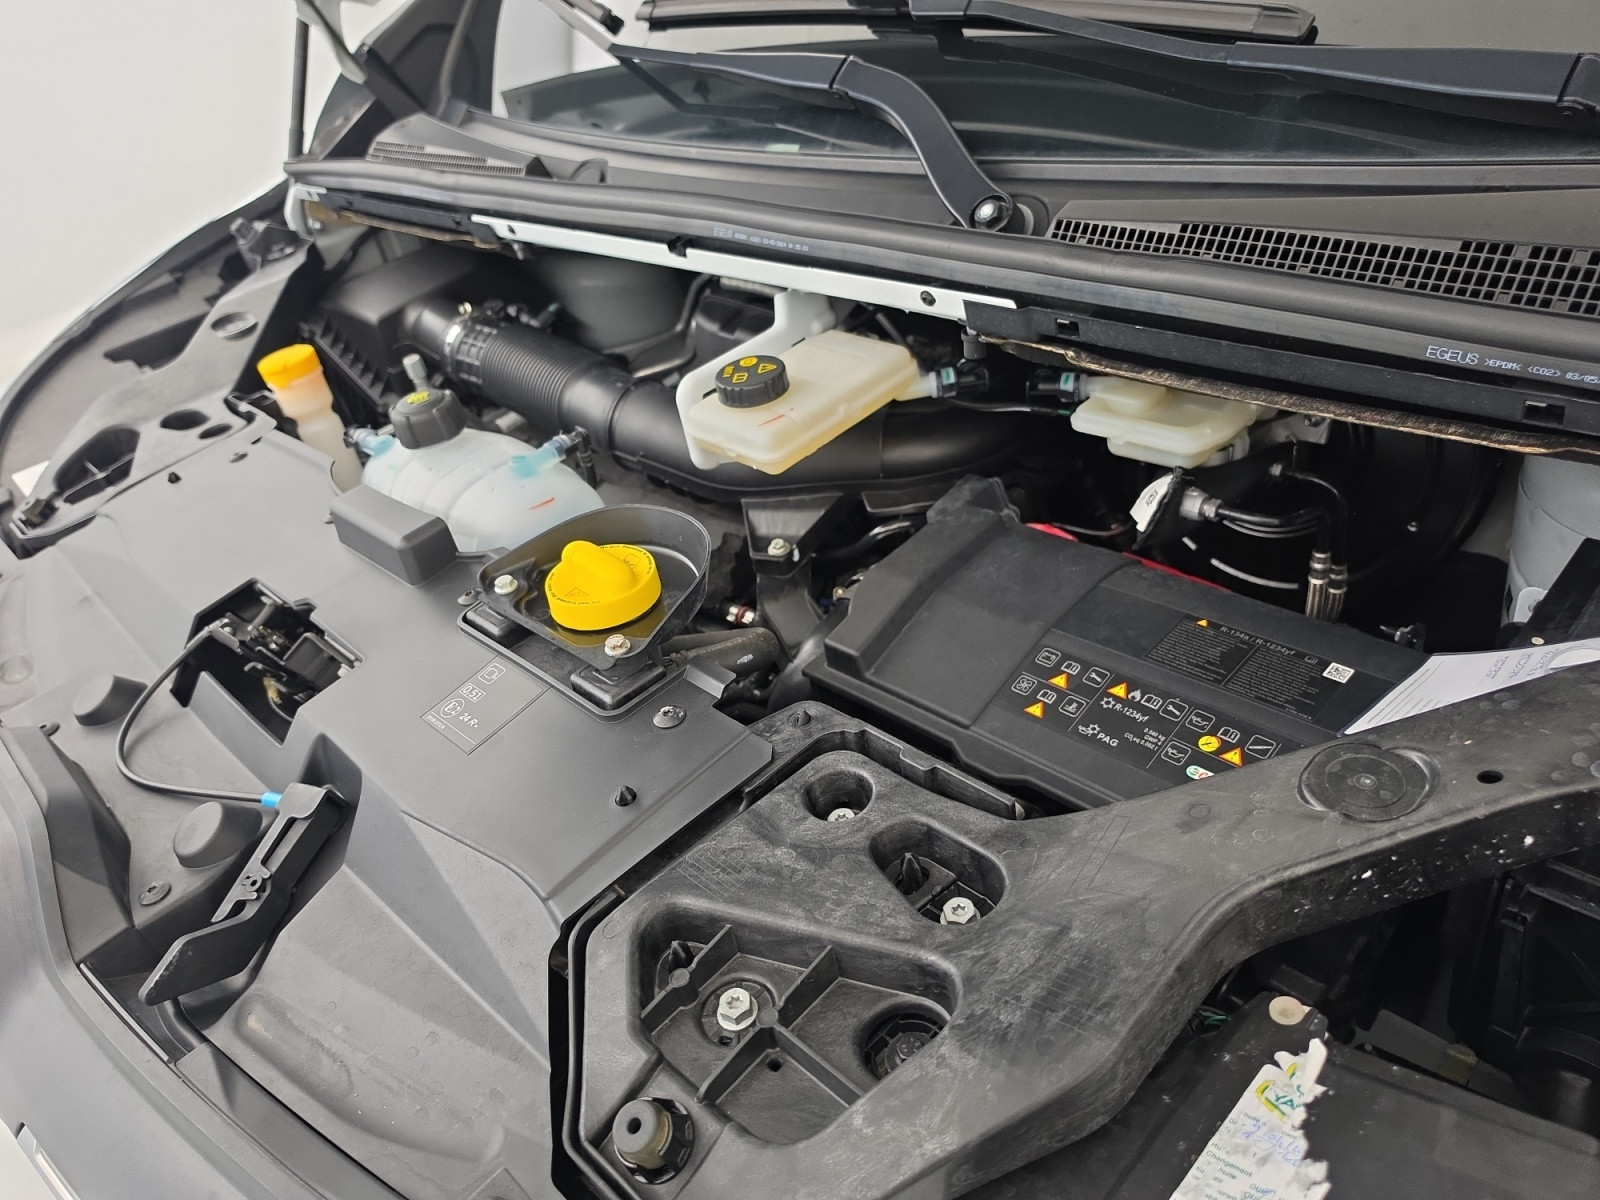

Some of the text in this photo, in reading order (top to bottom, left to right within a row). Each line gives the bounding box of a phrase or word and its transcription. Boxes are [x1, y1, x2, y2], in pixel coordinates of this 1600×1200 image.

[1426, 345, 1480, 365] EGEUS
[1114, 703, 1149, 722] R-1234yf
[1097, 733, 1119, 746] PAG
[1205, 1150, 1253, 1178] Changement
